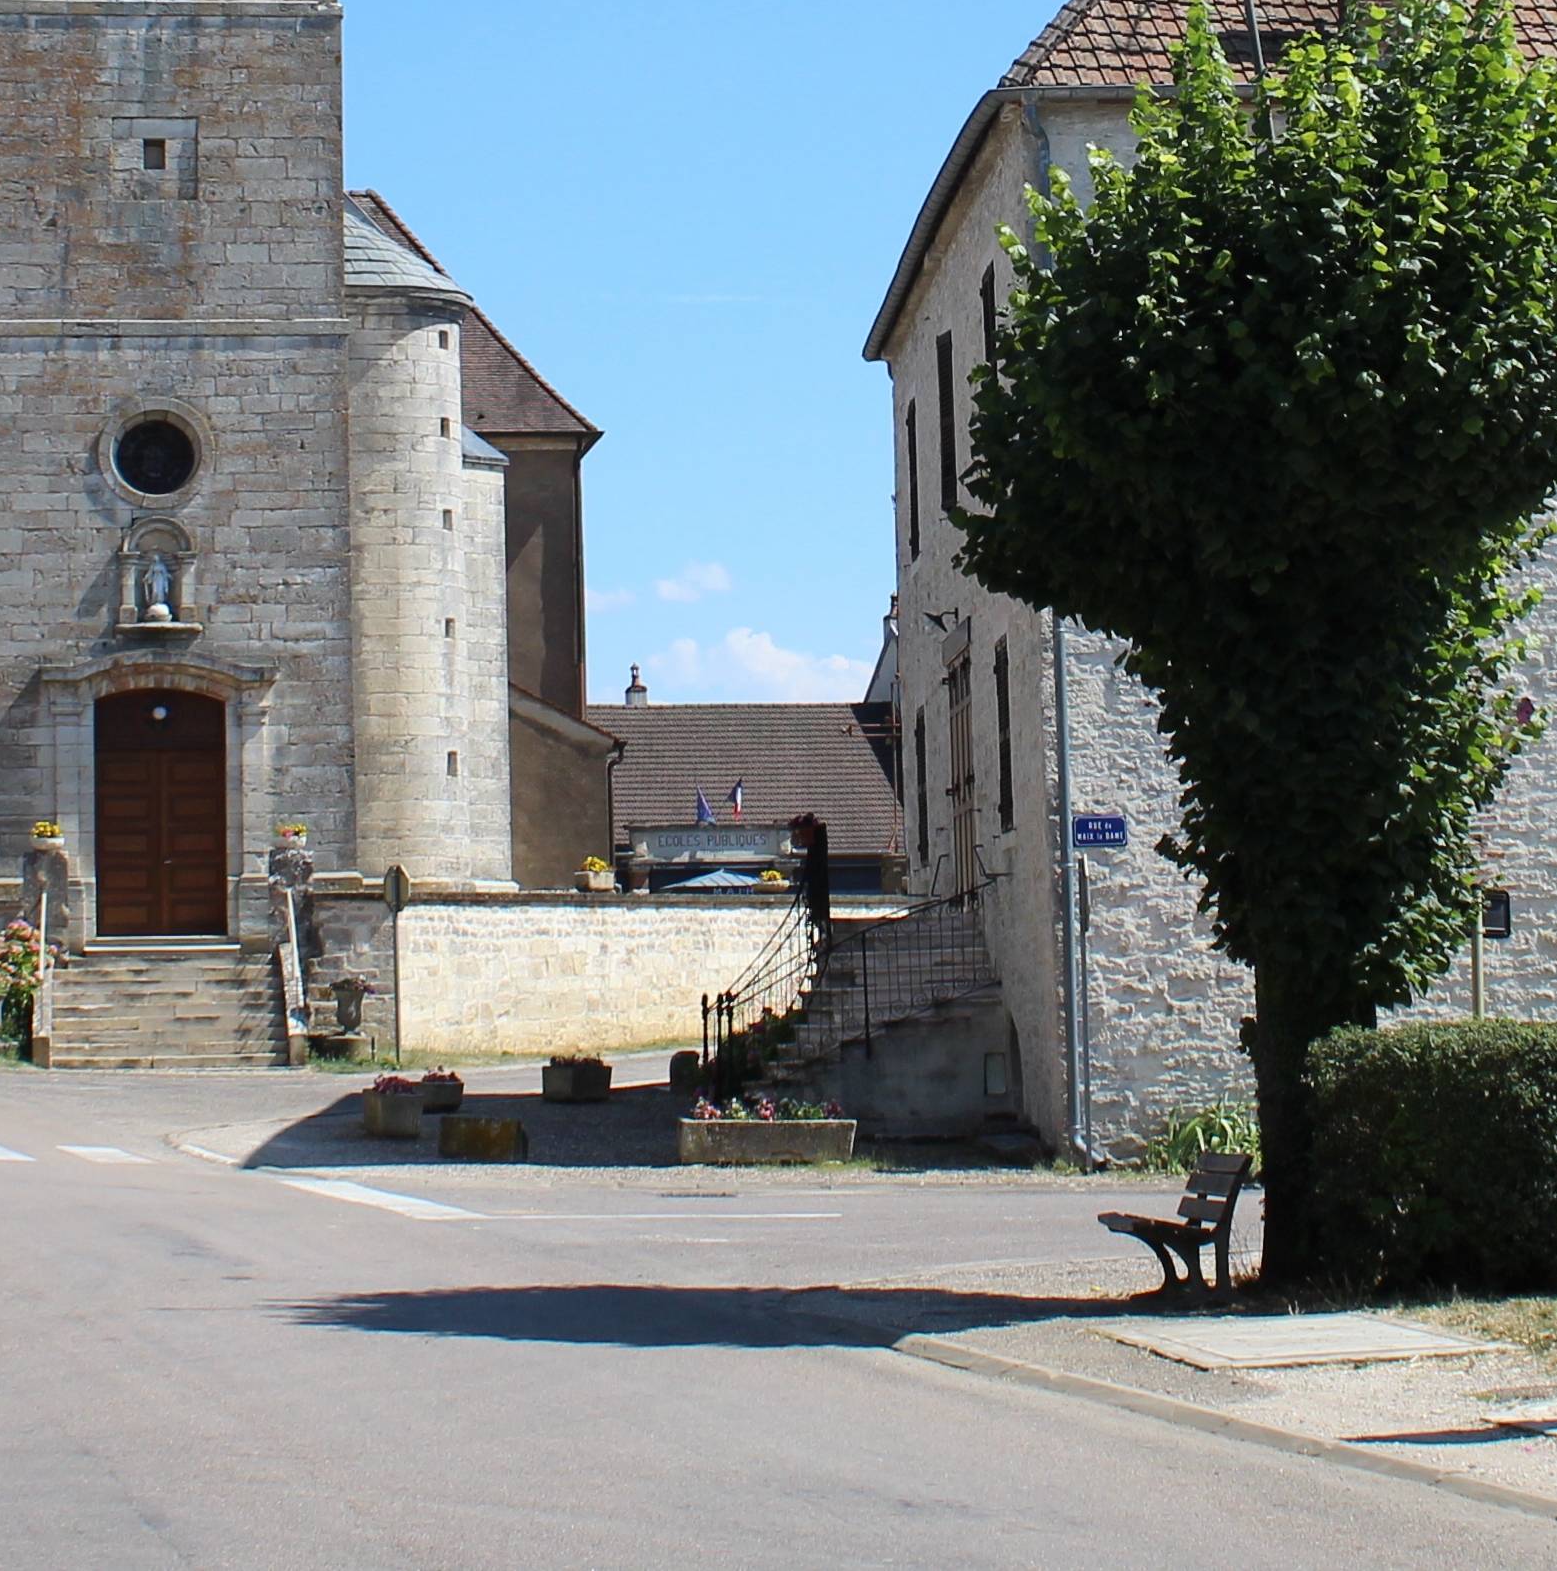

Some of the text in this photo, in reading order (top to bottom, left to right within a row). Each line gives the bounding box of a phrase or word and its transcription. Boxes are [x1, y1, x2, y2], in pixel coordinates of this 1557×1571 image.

[1088, 821, 1102, 830] RUE
[1105, 831, 1124, 840] DAME
[658, 833, 767, 848] ECOLES PUBLIQUES
